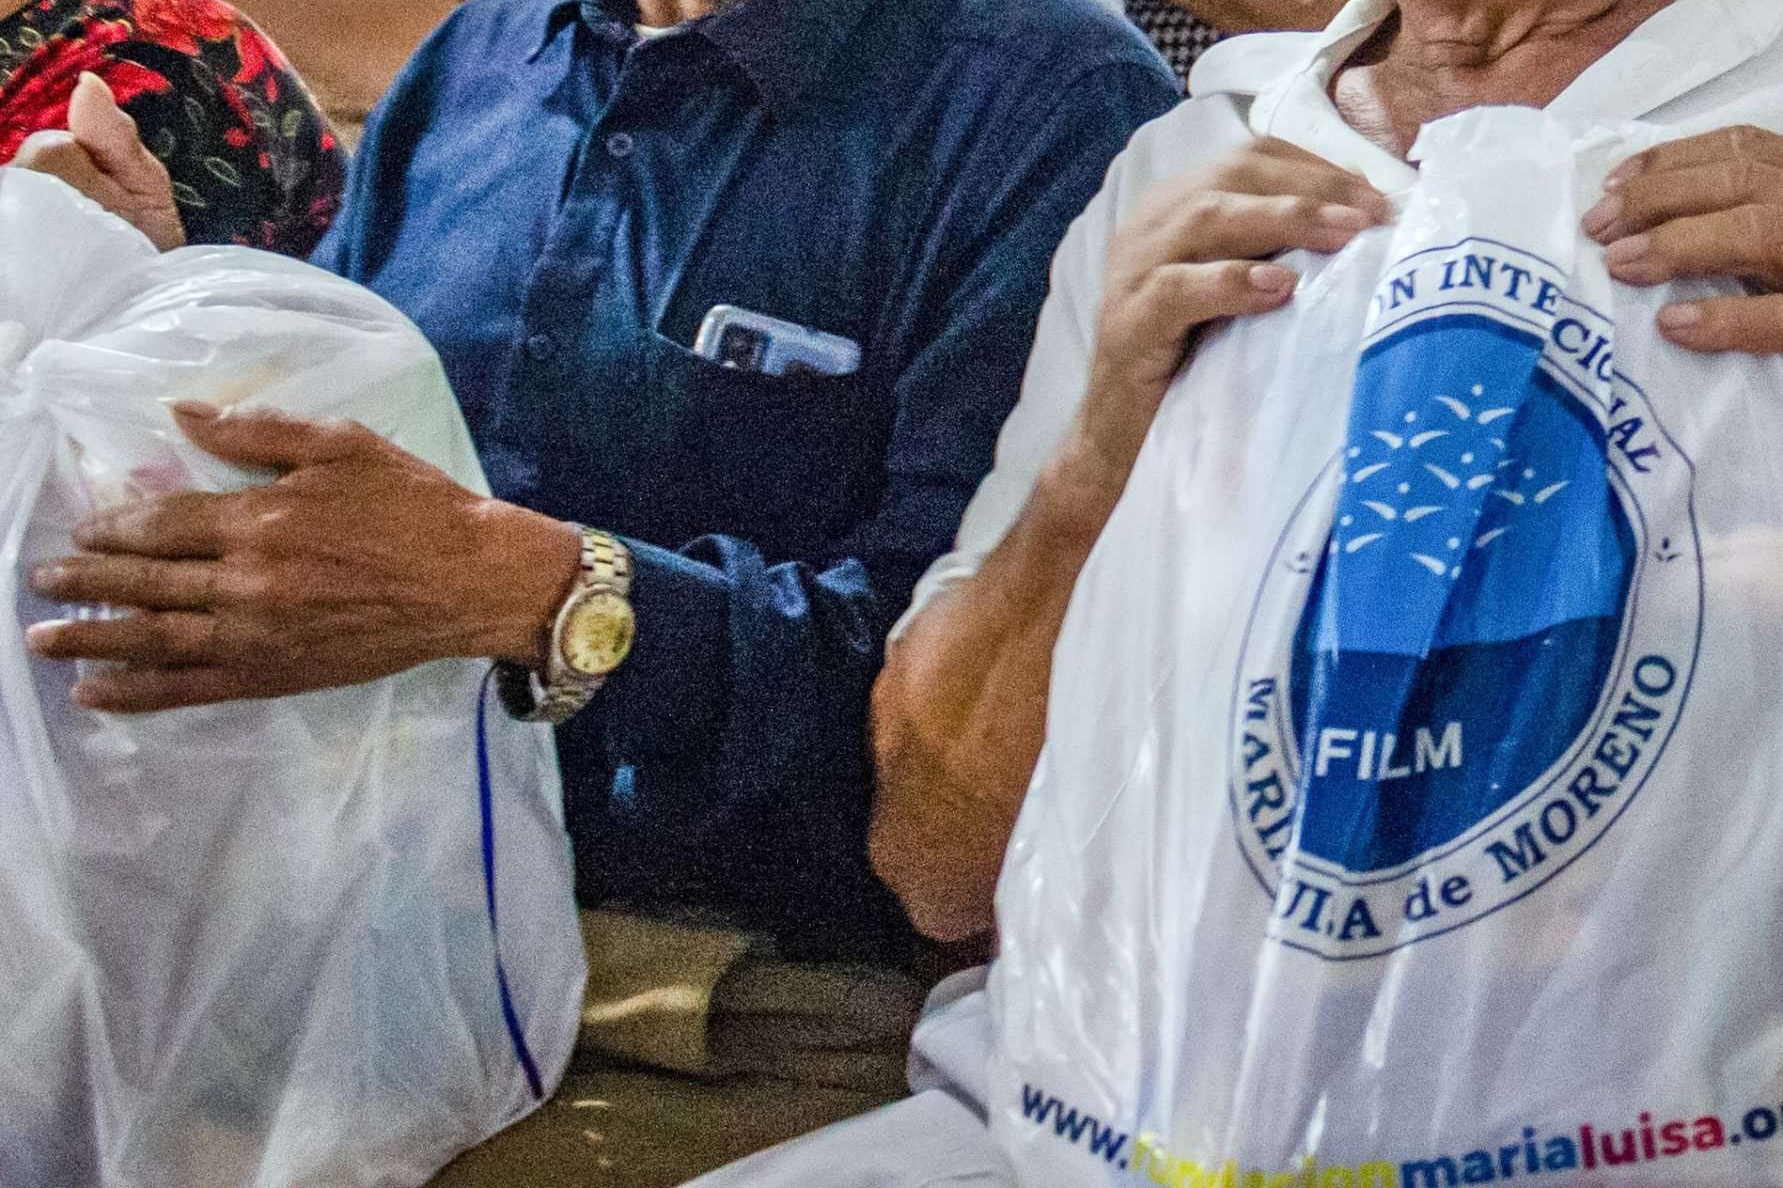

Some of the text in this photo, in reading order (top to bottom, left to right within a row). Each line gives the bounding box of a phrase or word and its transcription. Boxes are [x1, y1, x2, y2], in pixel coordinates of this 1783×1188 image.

[1314, 721, 1463, 782] FILM
[1403, 874, 1473, 922] de
[1484, 654, 1677, 883] MORENO
